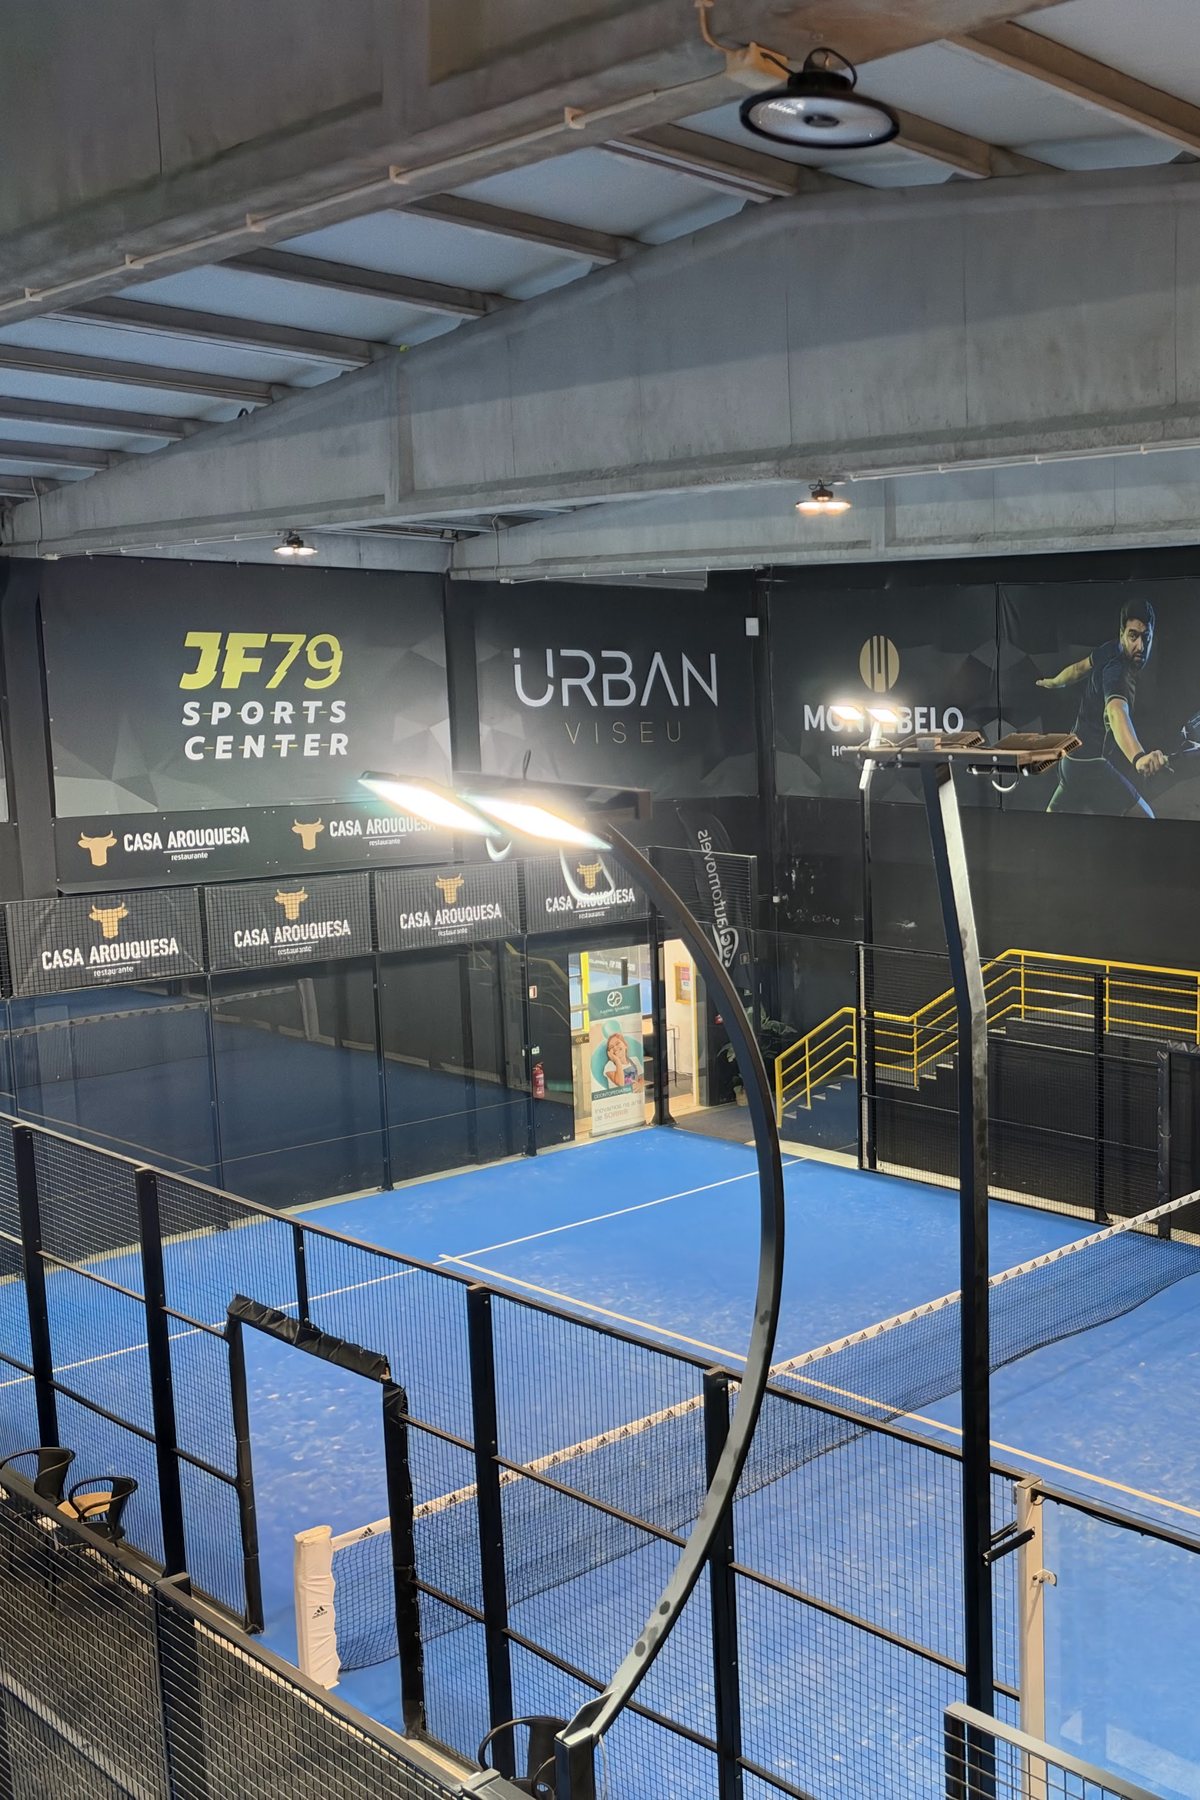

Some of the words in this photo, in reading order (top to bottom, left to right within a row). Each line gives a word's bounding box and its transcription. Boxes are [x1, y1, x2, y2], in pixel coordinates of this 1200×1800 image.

[179, 631, 343, 689] JF79
[513, 648, 718, 707] URBAN
[182, 700, 346, 726] SPORTS
[803, 704, 964, 734] MOBELO
[565, 721, 681, 744] VISEU
[184, 733, 349, 760] CENTER
[123, 832, 162, 852] CASA
[167, 826, 250, 849] AROUQUESA
[329, 819, 362, 837] CASA
[171, 852, 208, 861] restaurante
[400, 911, 431, 929] CASA
[434, 903, 502, 925] AROUQUESA
[545, 895, 573, 912] CASA
[234, 928, 269, 948] CASA
[274, 919, 351, 943] AROUQUESA
[42, 947, 84, 970] CASA
[90, 937, 179, 964] AROUQUESA
[94, 965, 134, 977] restaurante
